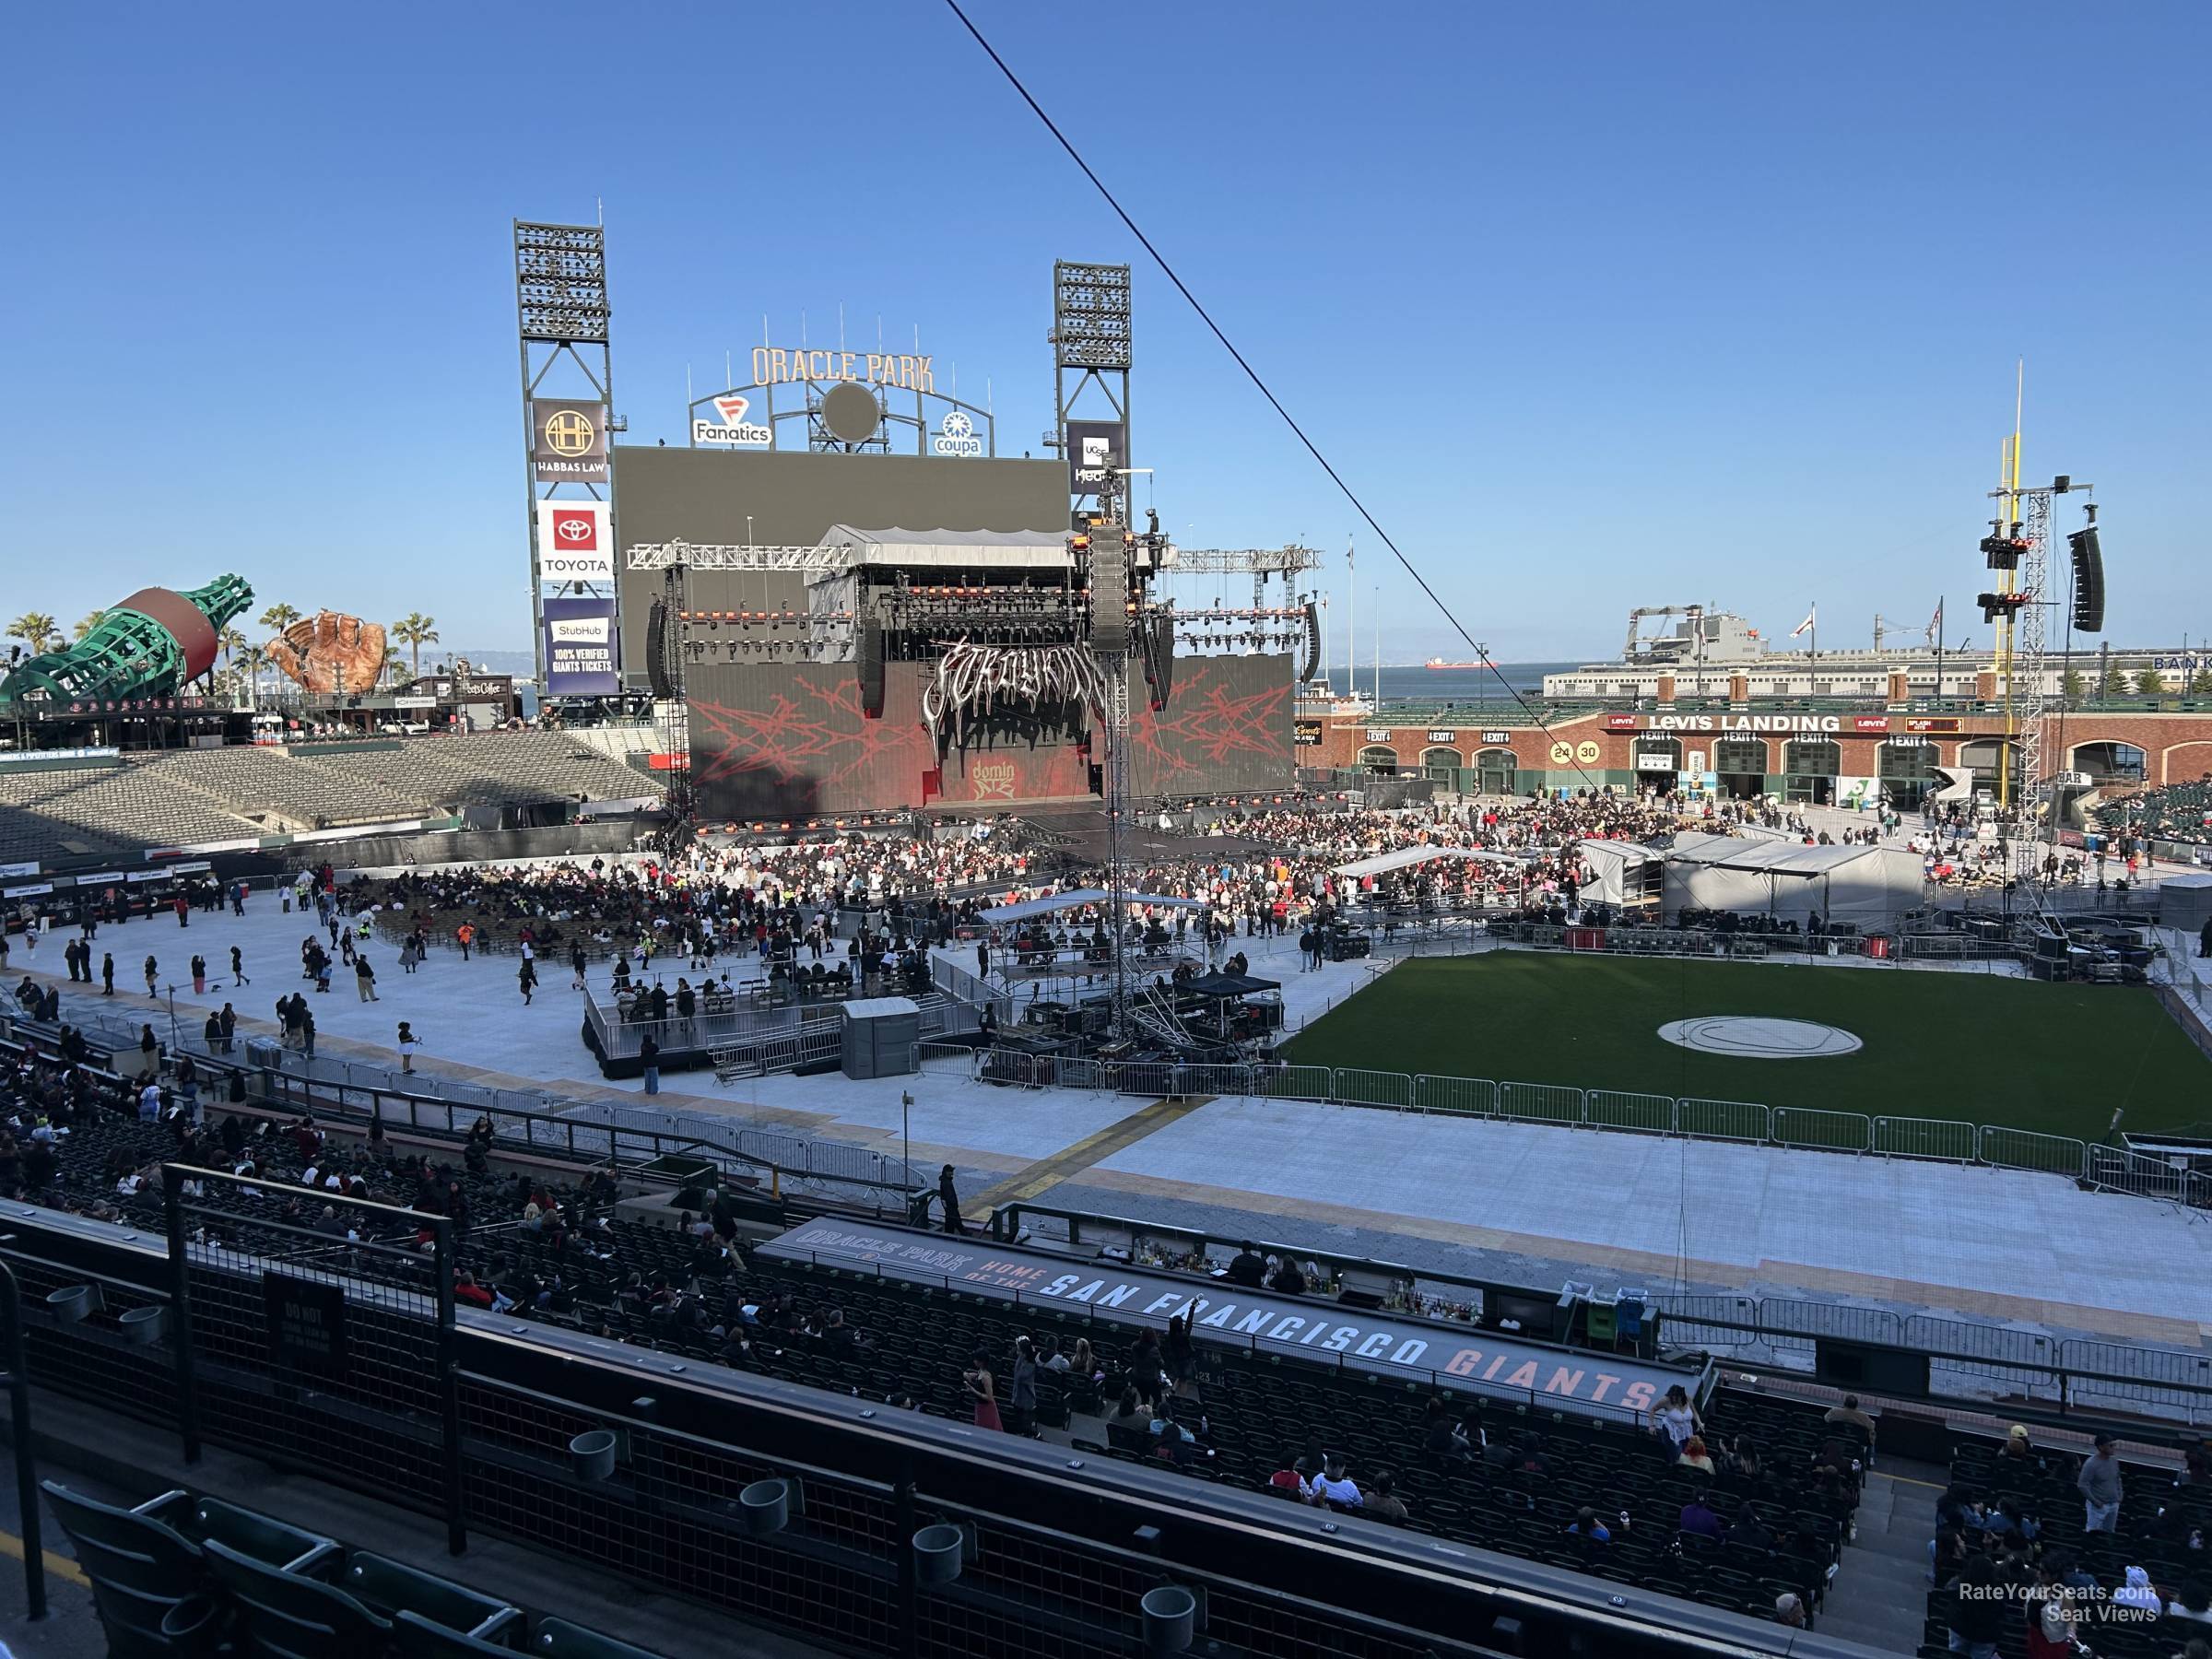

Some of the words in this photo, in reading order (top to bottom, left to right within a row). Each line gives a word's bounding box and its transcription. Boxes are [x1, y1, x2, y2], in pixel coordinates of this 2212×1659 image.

[752, 347, 857, 386] ORACLE
[865, 353, 935, 394] PARK
[697, 422, 769, 441] Fanatics
[937, 440, 979, 454] coupa
[538, 462, 581, 472] HABBAS
[582, 463, 605, 473] LAW
[545, 559, 608, 571] TOYOTA
[559, 626, 602, 635] StubHub
[554, 648, 575, 660] 100%
[575, 648, 609, 660] VERIFIED
[552, 660, 580, 673] GIANTS
[581, 660, 612, 672] TICKETS
[481, 682, 500, 695] Coffee
[1721, 715, 1841, 732] LANDING
[1371, 733, 1386, 742] EXIT
[1433, 732, 1451, 742] EXIT
[1487, 732, 1505, 743] EXIT
[1646, 731, 1665, 740] EXIT
[1729, 732, 1751, 742] EXIT
[1800, 733, 1823, 743] EXIT
[1895, 736, 1921, 747] EXIT
[1554, 747, 1570, 758] 24
[1581, 747, 1595, 758] 30
[972, 759, 1015, 782] domin
[2058, 772, 2081, 783] BAR
[795, 1229, 903, 1254] ORACLE
[899, 1244, 974, 1272] PARK
[980, 1260, 1048, 1280] HOME
[965, 1270, 991, 1281] OF
[995, 1277, 1031, 1289] THE
[1040, 1274, 1142, 1308] SAN
[1142, 1292, 1431, 1366] FRANCISCO
[1443, 1347, 1657, 1409] GIANTS
